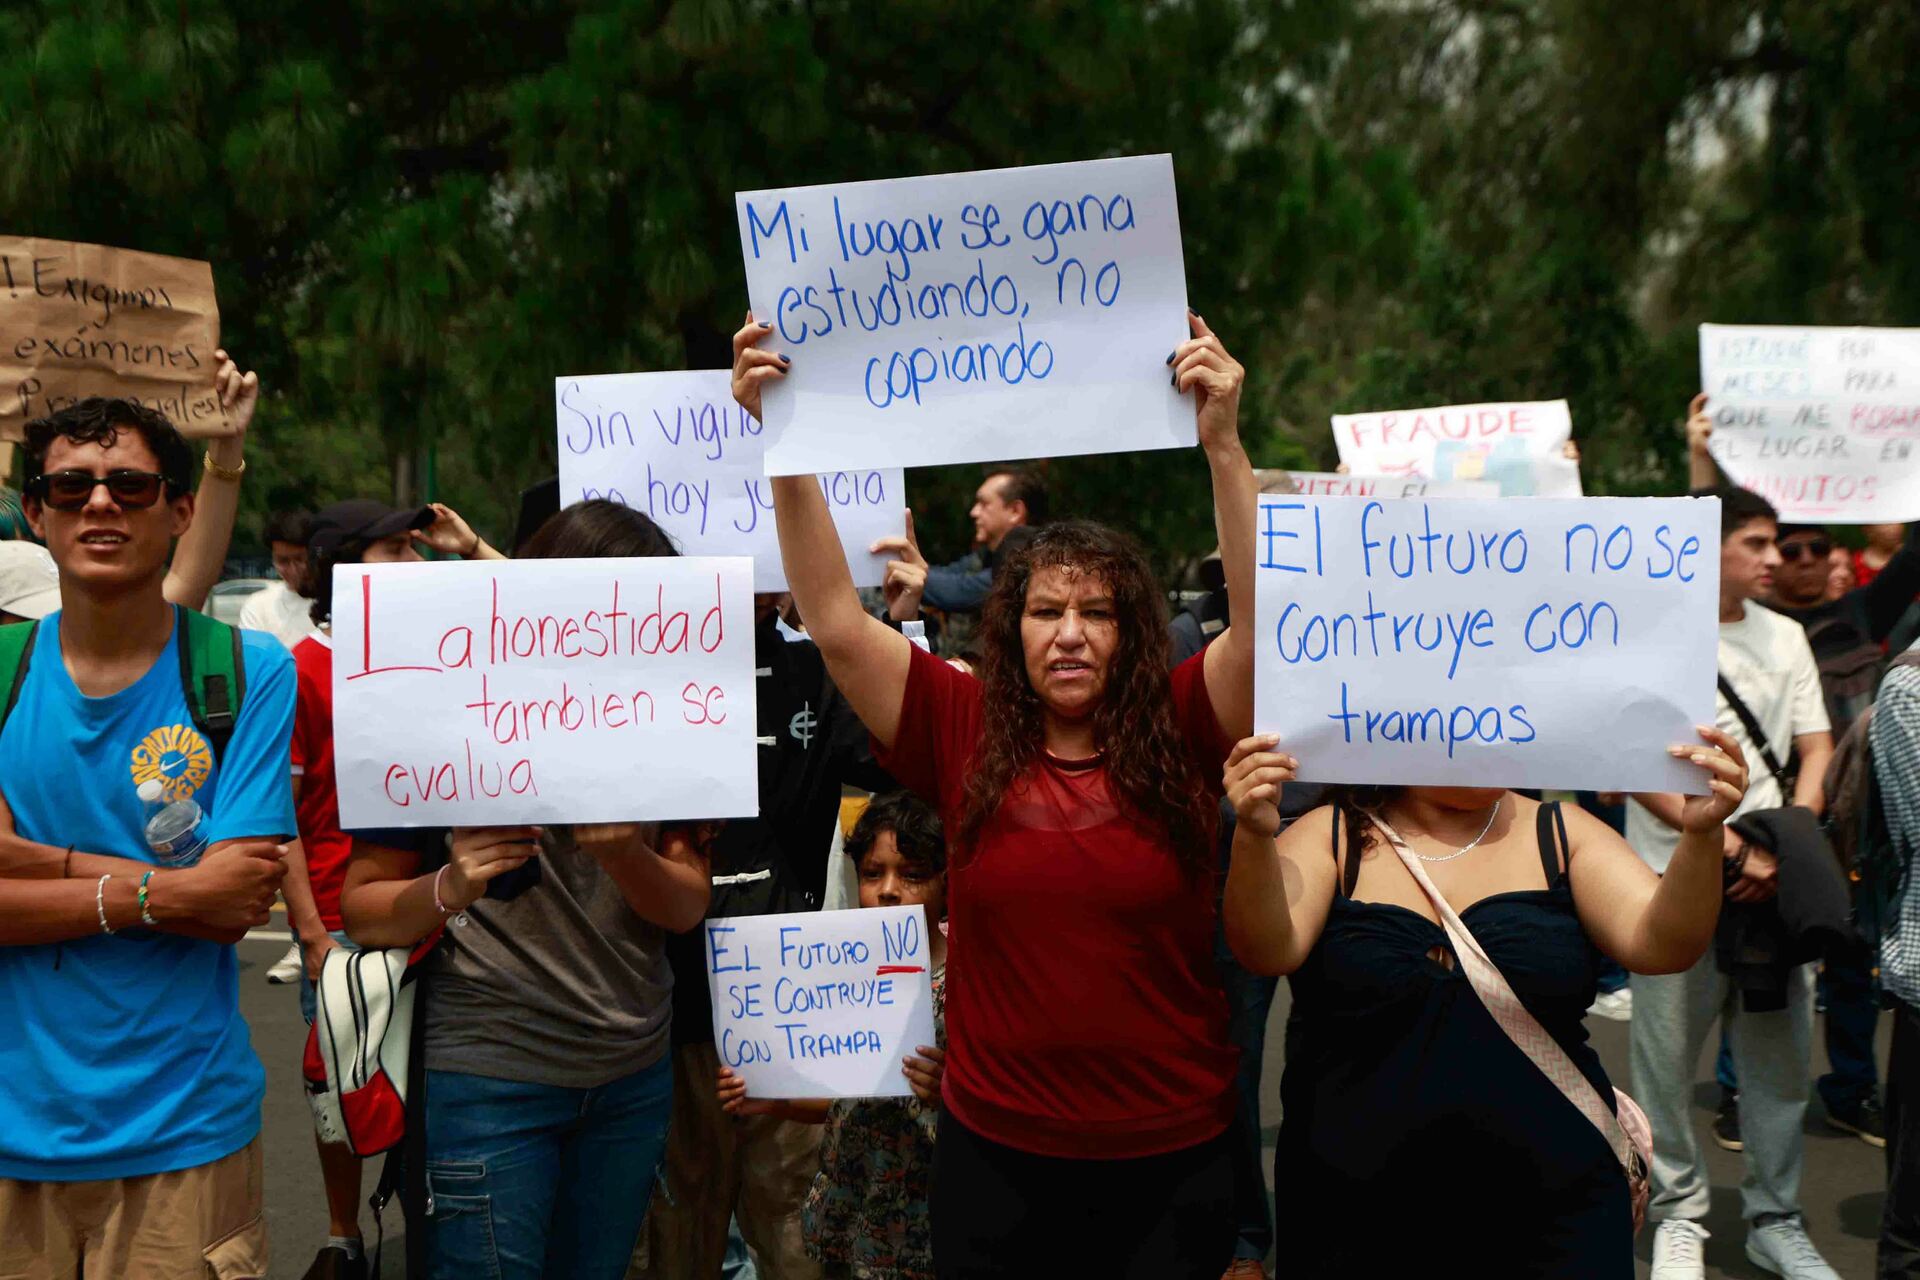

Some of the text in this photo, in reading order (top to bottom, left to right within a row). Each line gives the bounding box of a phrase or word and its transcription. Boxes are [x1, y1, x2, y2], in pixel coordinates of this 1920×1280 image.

[746, 193, 1135, 281] Mi lugar se gana
[777, 257, 1121, 344] estudiando, no
[864, 322, 1053, 408] copiando
[561, 380, 635, 454] Sin
[1349, 408, 1538, 449] FRAUDE
[1757, 434, 1851, 461] LUGAR
[647, 462, 710, 536] hay
[1258, 503, 1324, 576] El
[1565, 523, 1634, 575] no
[347, 573, 725, 680] La honestidad
[1523, 600, 1620, 653] con
[465, 674, 728, 745] tambien se
[1327, 682, 1537, 760] trampas
[384, 738, 540, 807] evalua
[881, 914, 920, 963] NO
[729, 975, 895, 1019] SE CONTRUYE
[774, 1023, 883, 1060] TRAMPA
